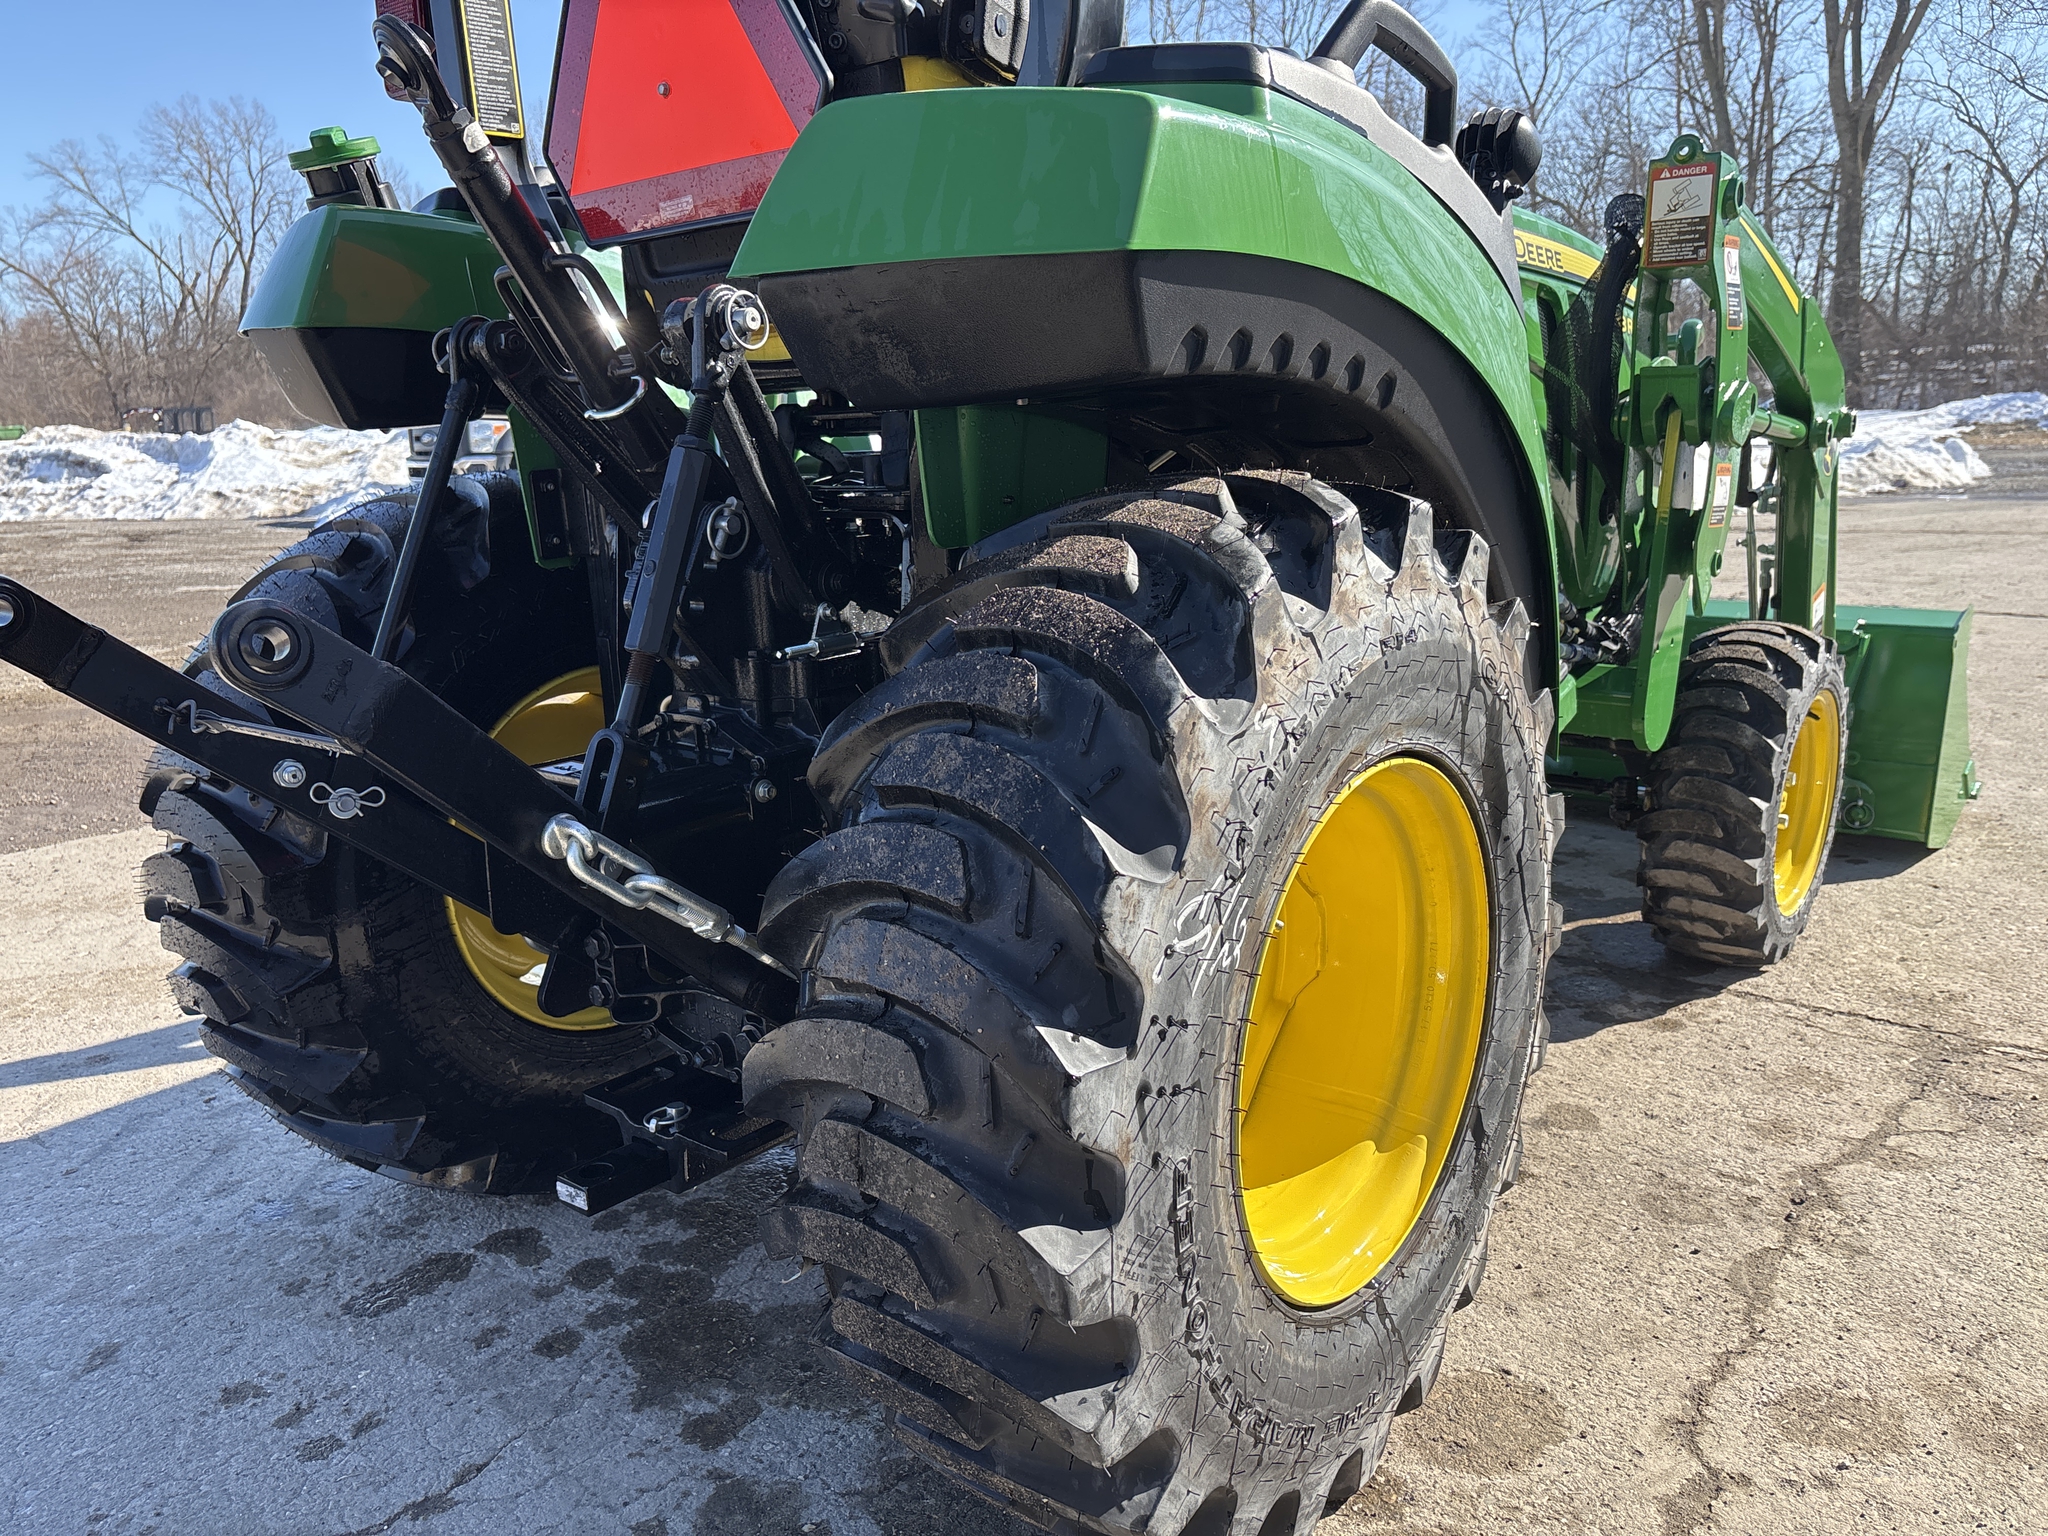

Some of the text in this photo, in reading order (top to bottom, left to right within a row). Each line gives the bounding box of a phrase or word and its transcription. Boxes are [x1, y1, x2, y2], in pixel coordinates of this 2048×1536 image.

[1672, 165, 1708, 177] DANGER
[1514, 235, 1564, 270] DEERE
[1173, 1156, 1316, 1450] MARATHONER
